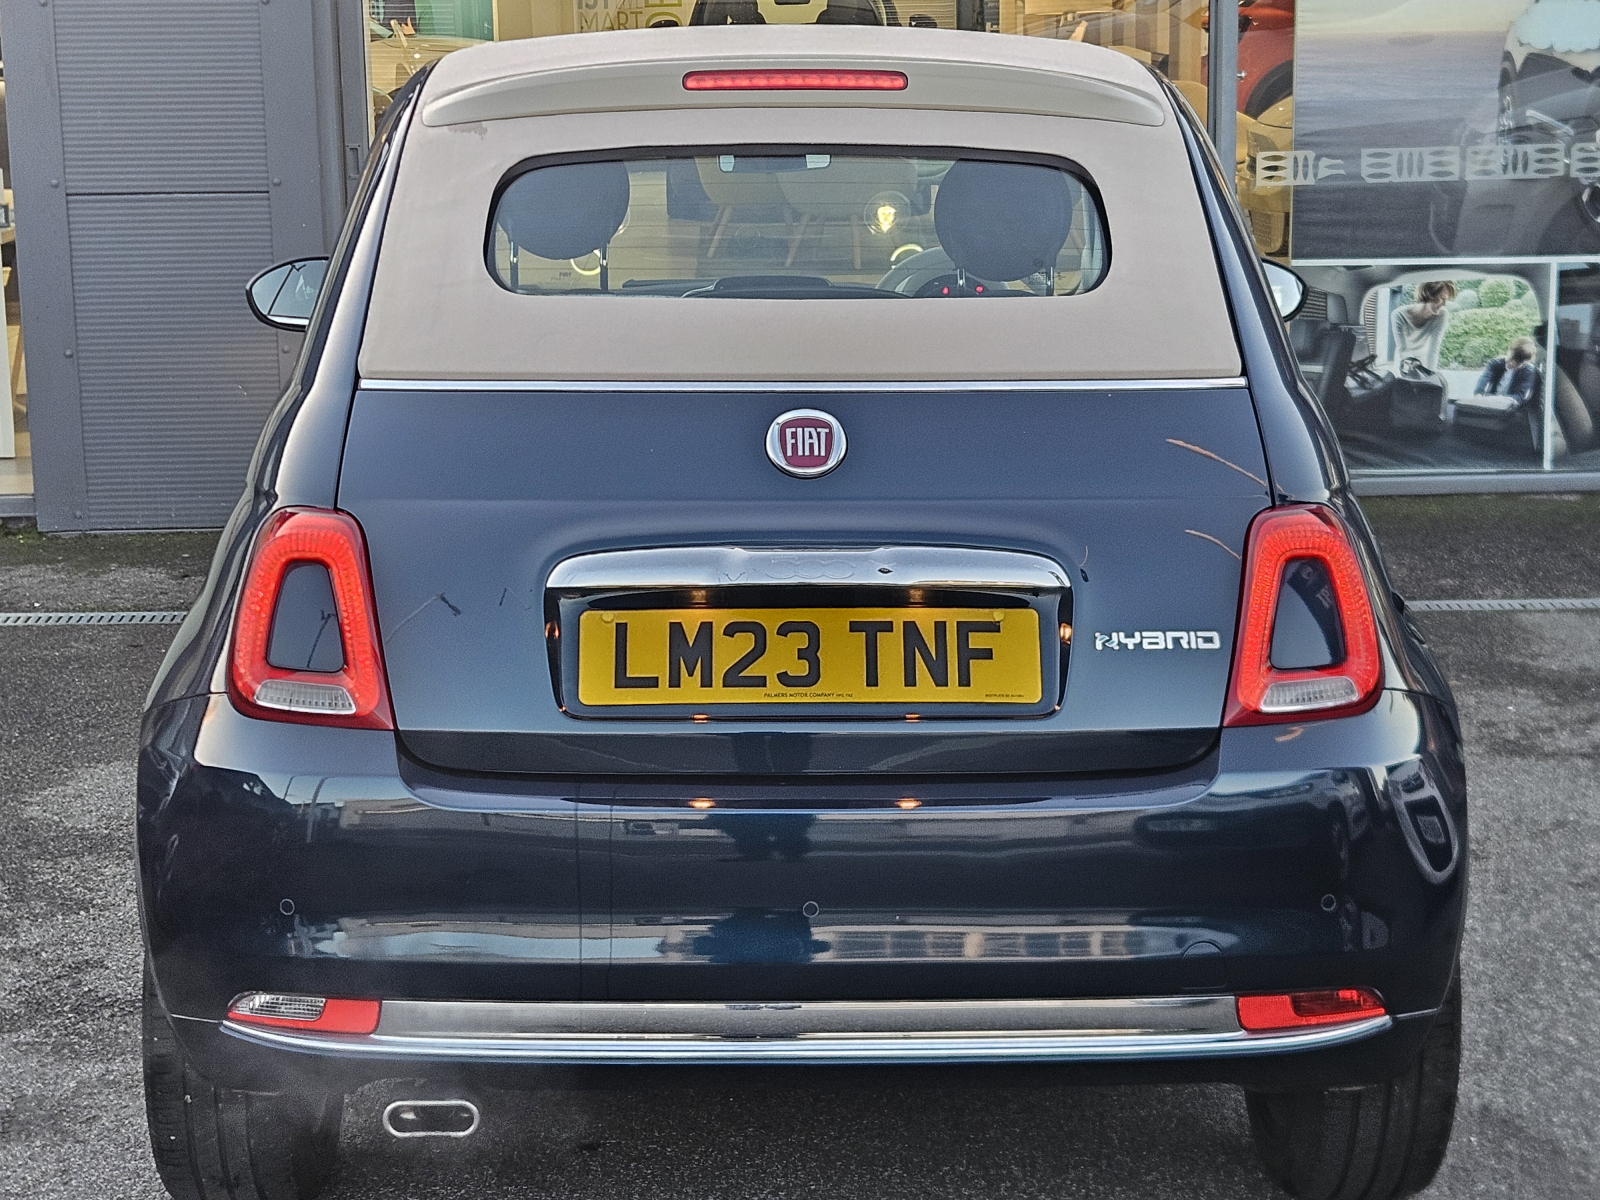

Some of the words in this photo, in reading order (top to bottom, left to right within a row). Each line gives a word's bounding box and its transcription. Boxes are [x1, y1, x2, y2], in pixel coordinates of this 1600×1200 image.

[785, 427, 830, 457] FIAT
[614, 620, 821, 689] LM23
[848, 620, 1002, 688] TNF
[1094, 631, 1220, 650] HYBRID
